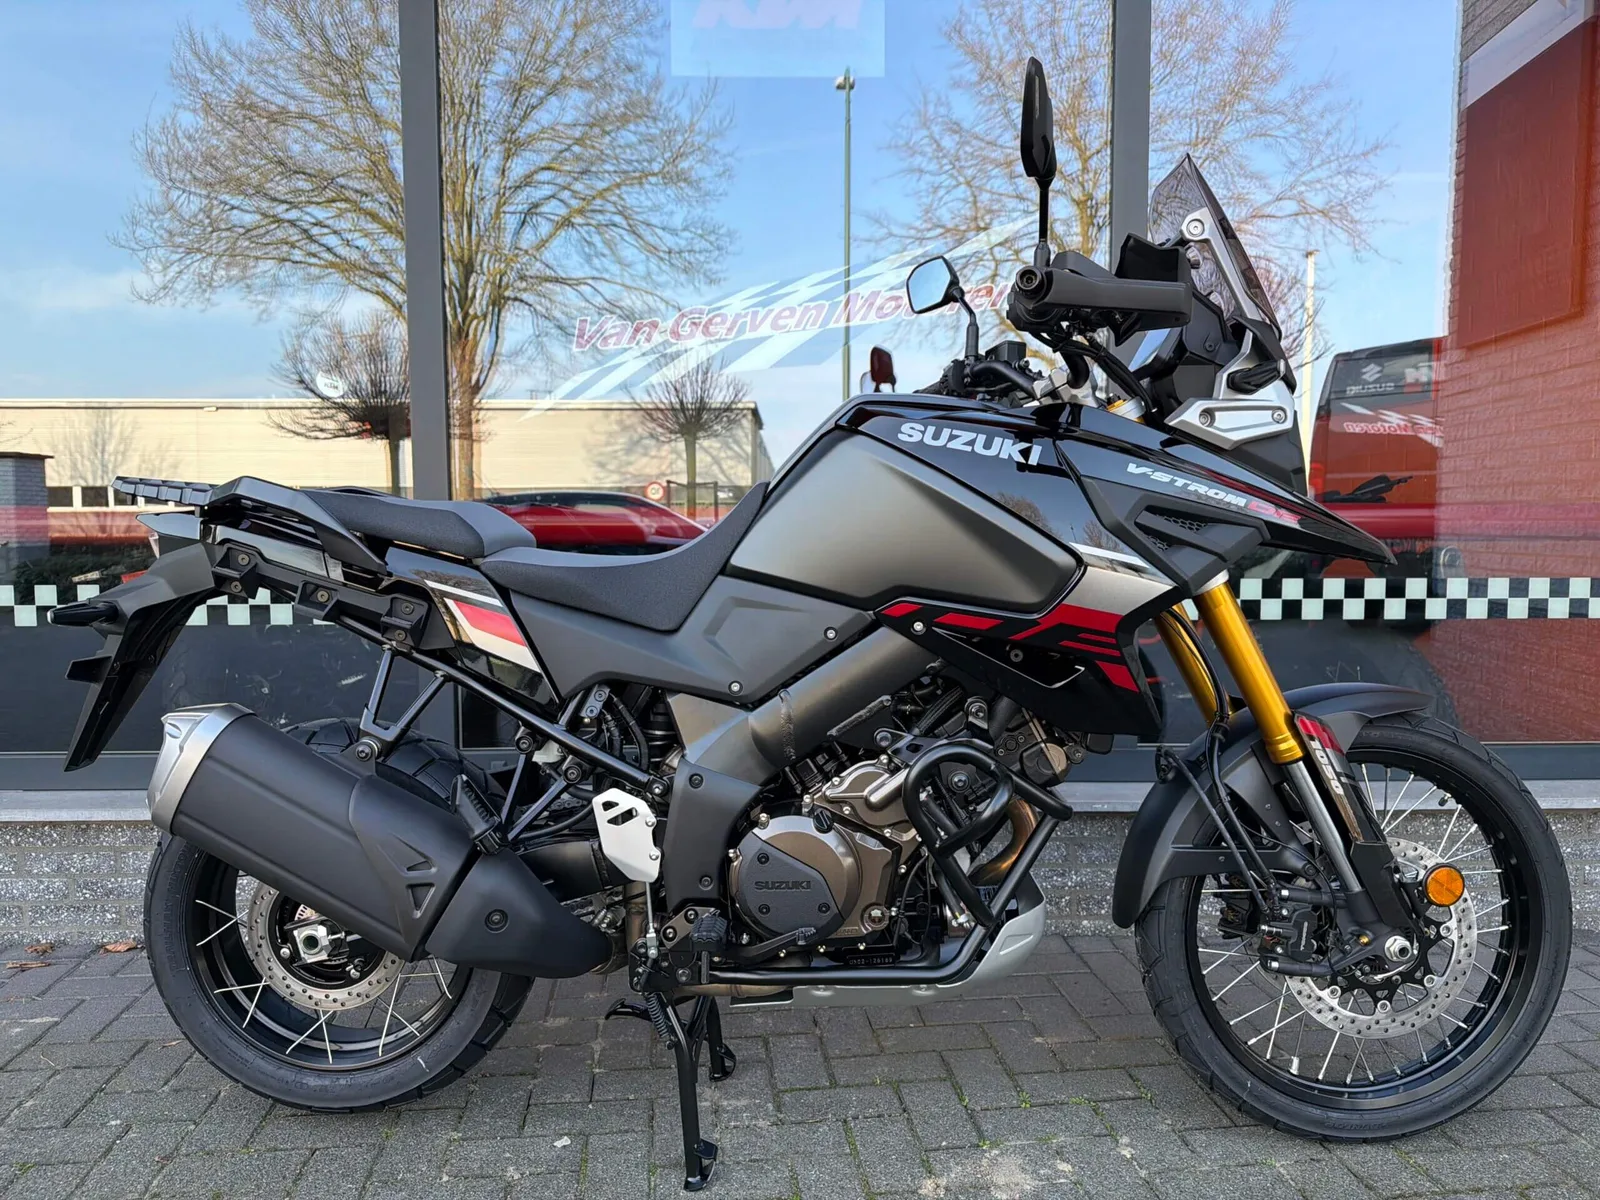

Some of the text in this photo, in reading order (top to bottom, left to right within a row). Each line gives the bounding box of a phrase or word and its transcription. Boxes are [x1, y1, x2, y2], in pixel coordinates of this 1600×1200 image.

[573, 315, 660, 350] Van
[668, 303, 829, 343] Gerven
[897, 422, 1043, 466] SUZUKI
[1126, 463, 1248, 507] V-STROM
[1309, 739, 1345, 796] 1050
[754, 880, 812, 892] SUZUKI
